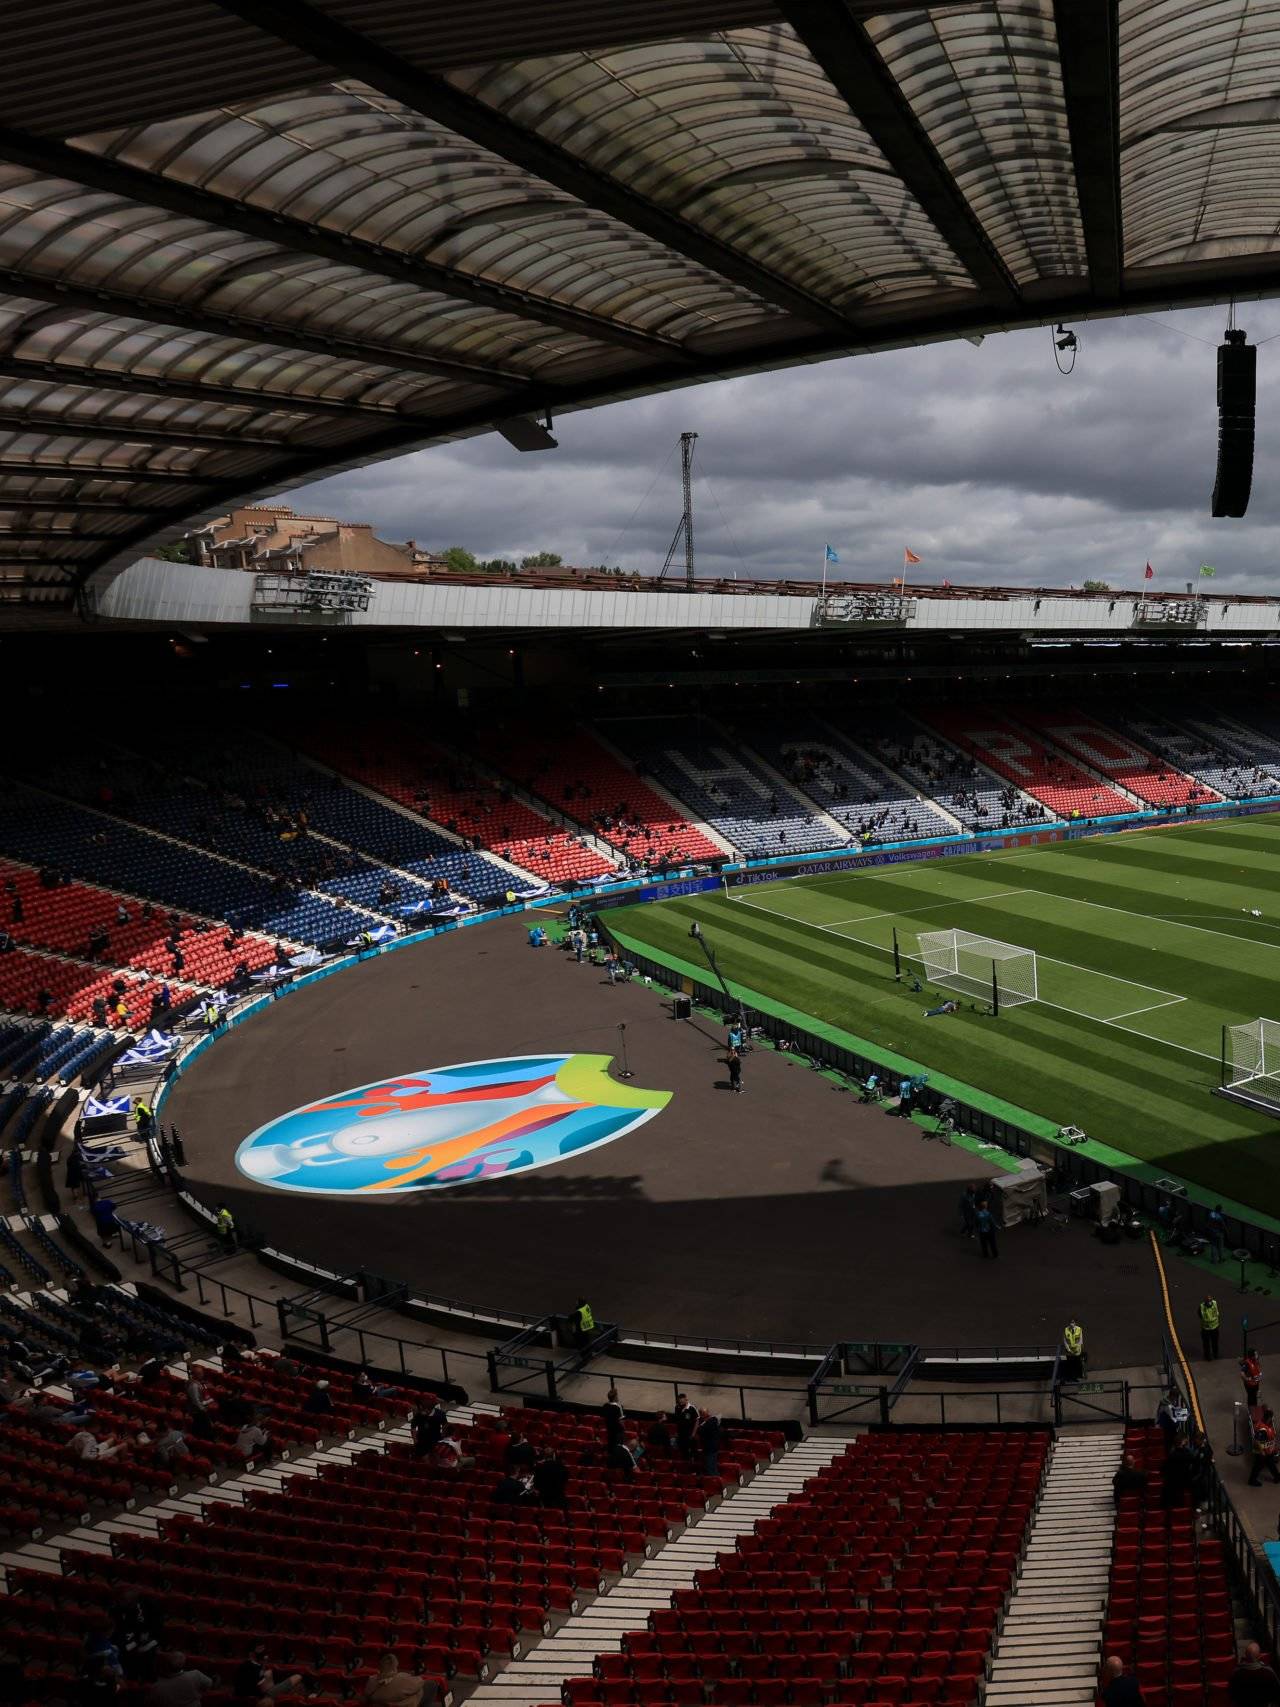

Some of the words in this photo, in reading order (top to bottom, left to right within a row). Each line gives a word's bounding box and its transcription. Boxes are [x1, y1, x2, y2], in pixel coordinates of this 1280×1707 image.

[888, 850, 936, 862] Volkswagen
[797, 861, 833, 875] QATAR
[834, 857, 875, 870] AIRWAYS
[747, 871, 779, 884] TikTok
